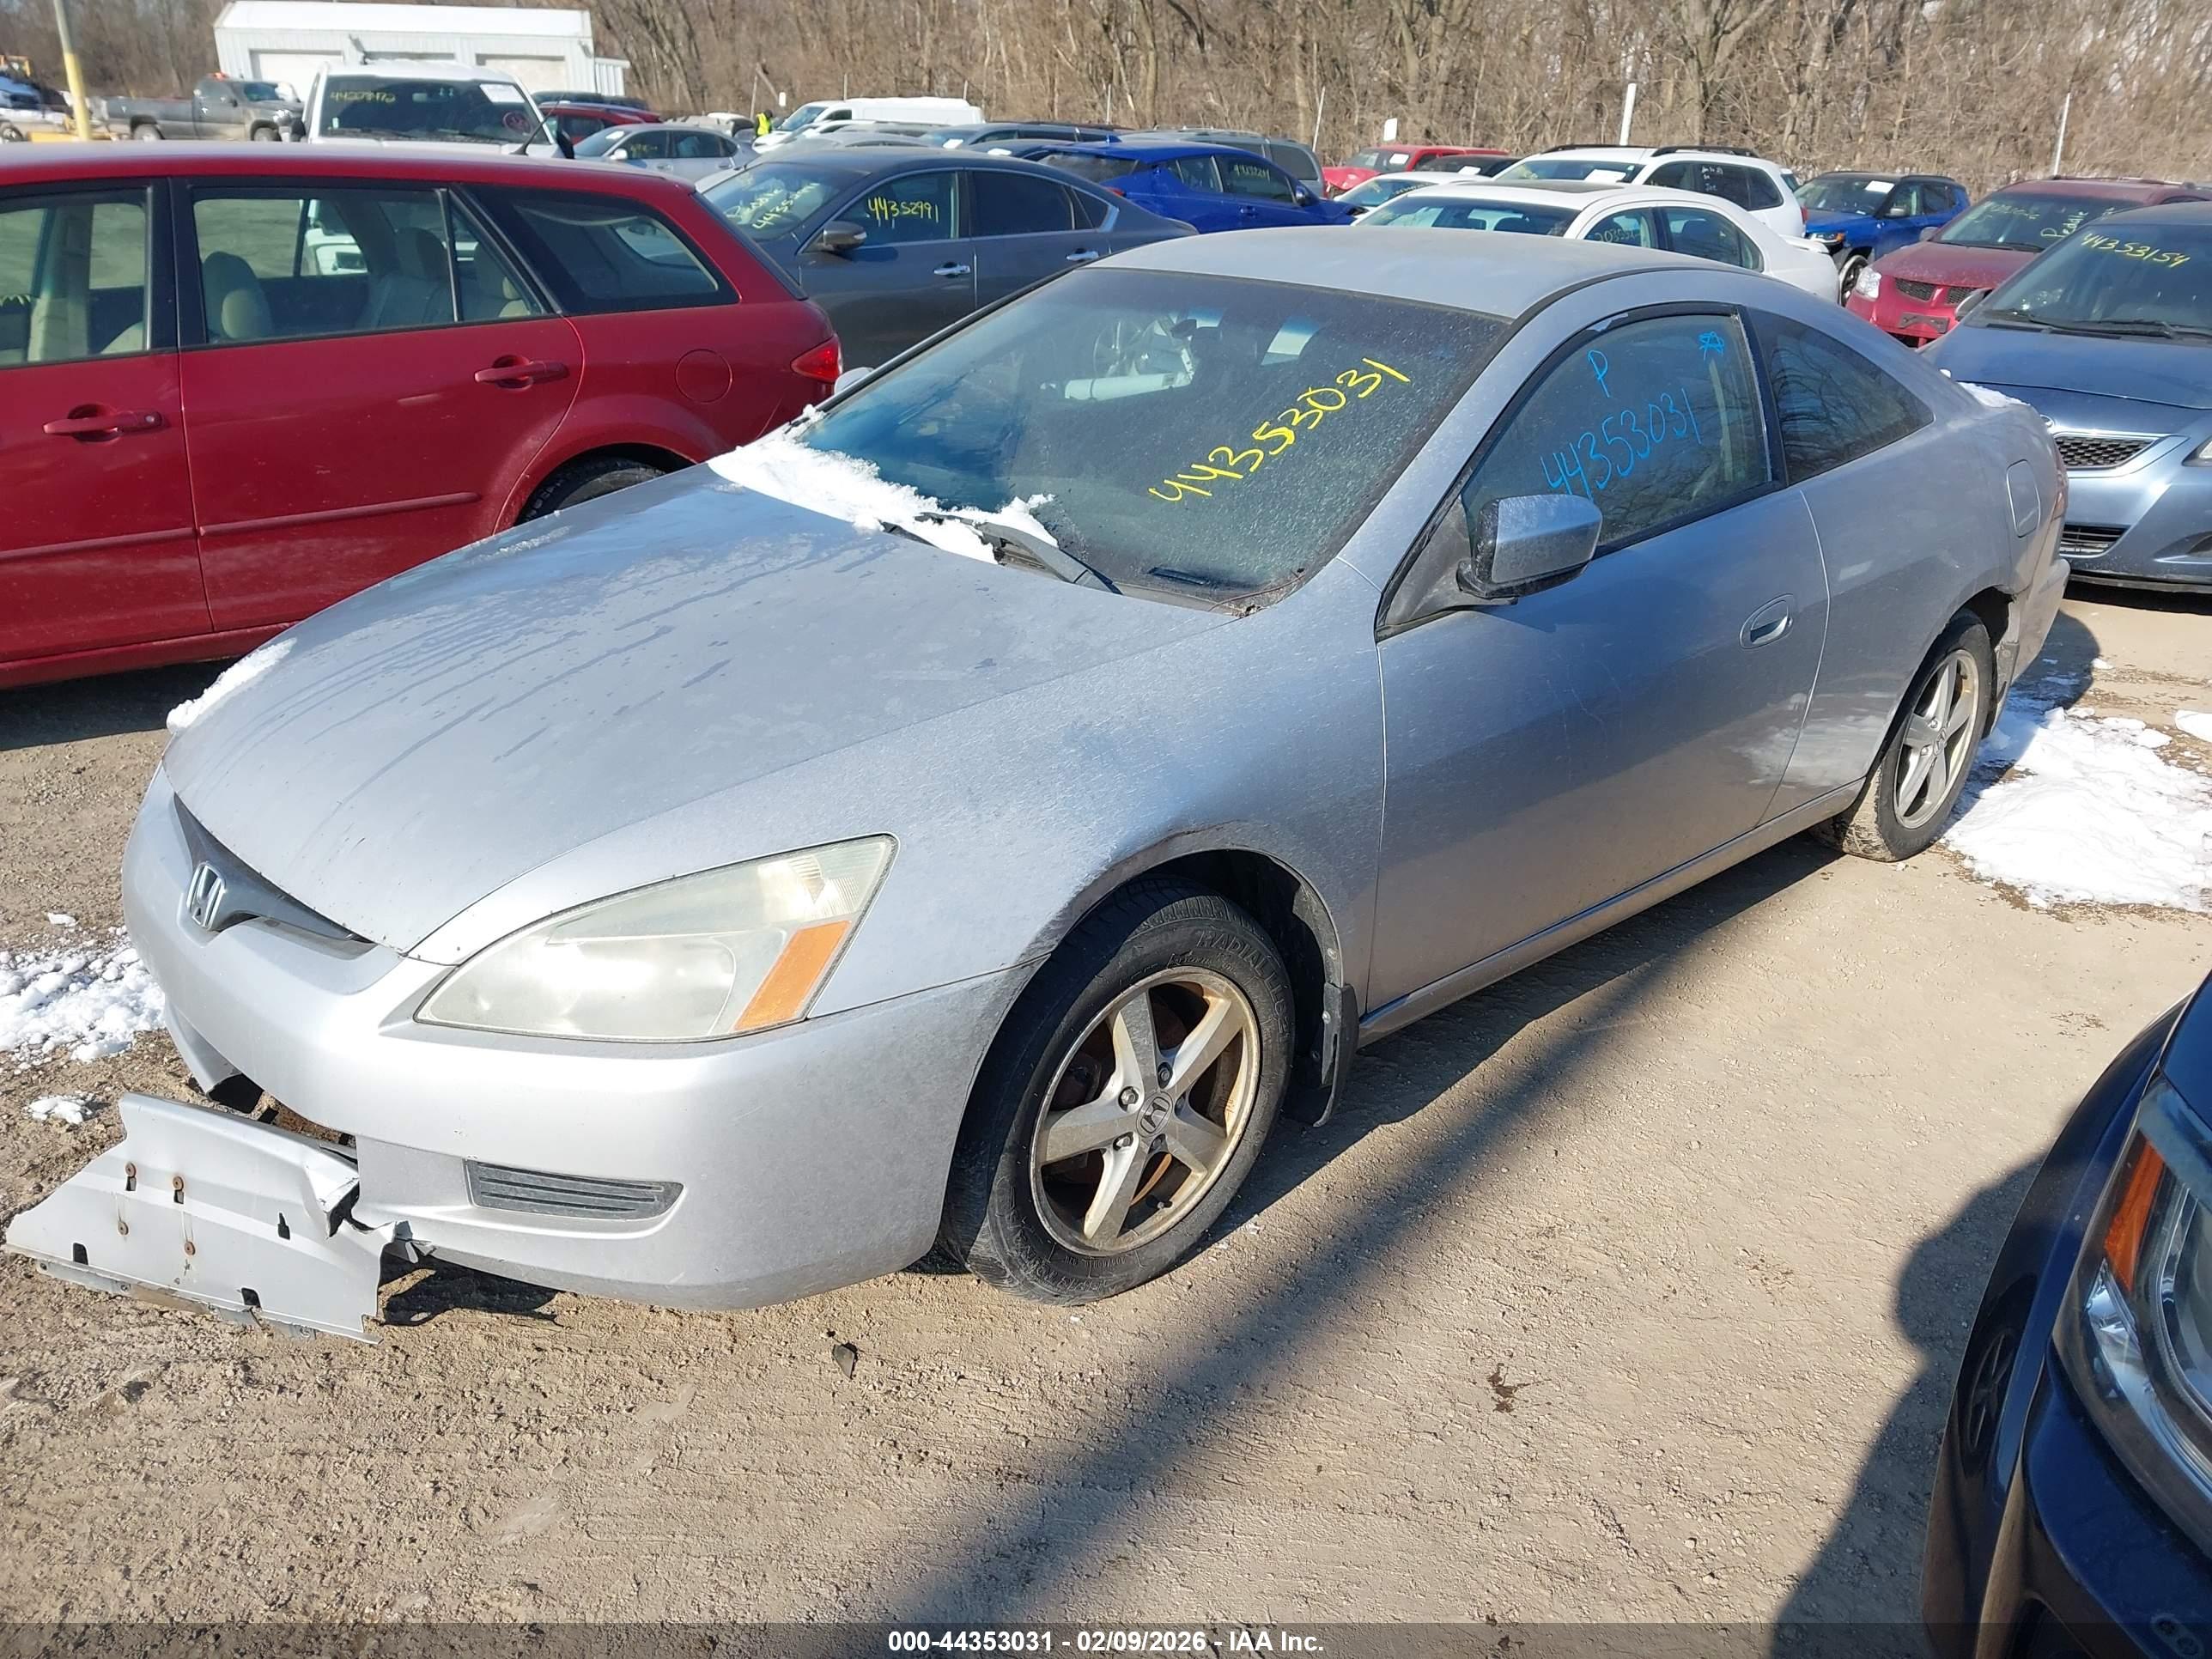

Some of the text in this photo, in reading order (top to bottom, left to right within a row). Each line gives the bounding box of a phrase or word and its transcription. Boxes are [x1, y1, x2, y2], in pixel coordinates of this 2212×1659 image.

[867, 196, 939, 225] 44352991
[2081, 233, 2191, 268] 44353154
[1587, 349, 1612, 398] P
[1147, 357, 1411, 501] 44353031
[1540, 387, 1702, 502] 44353031
